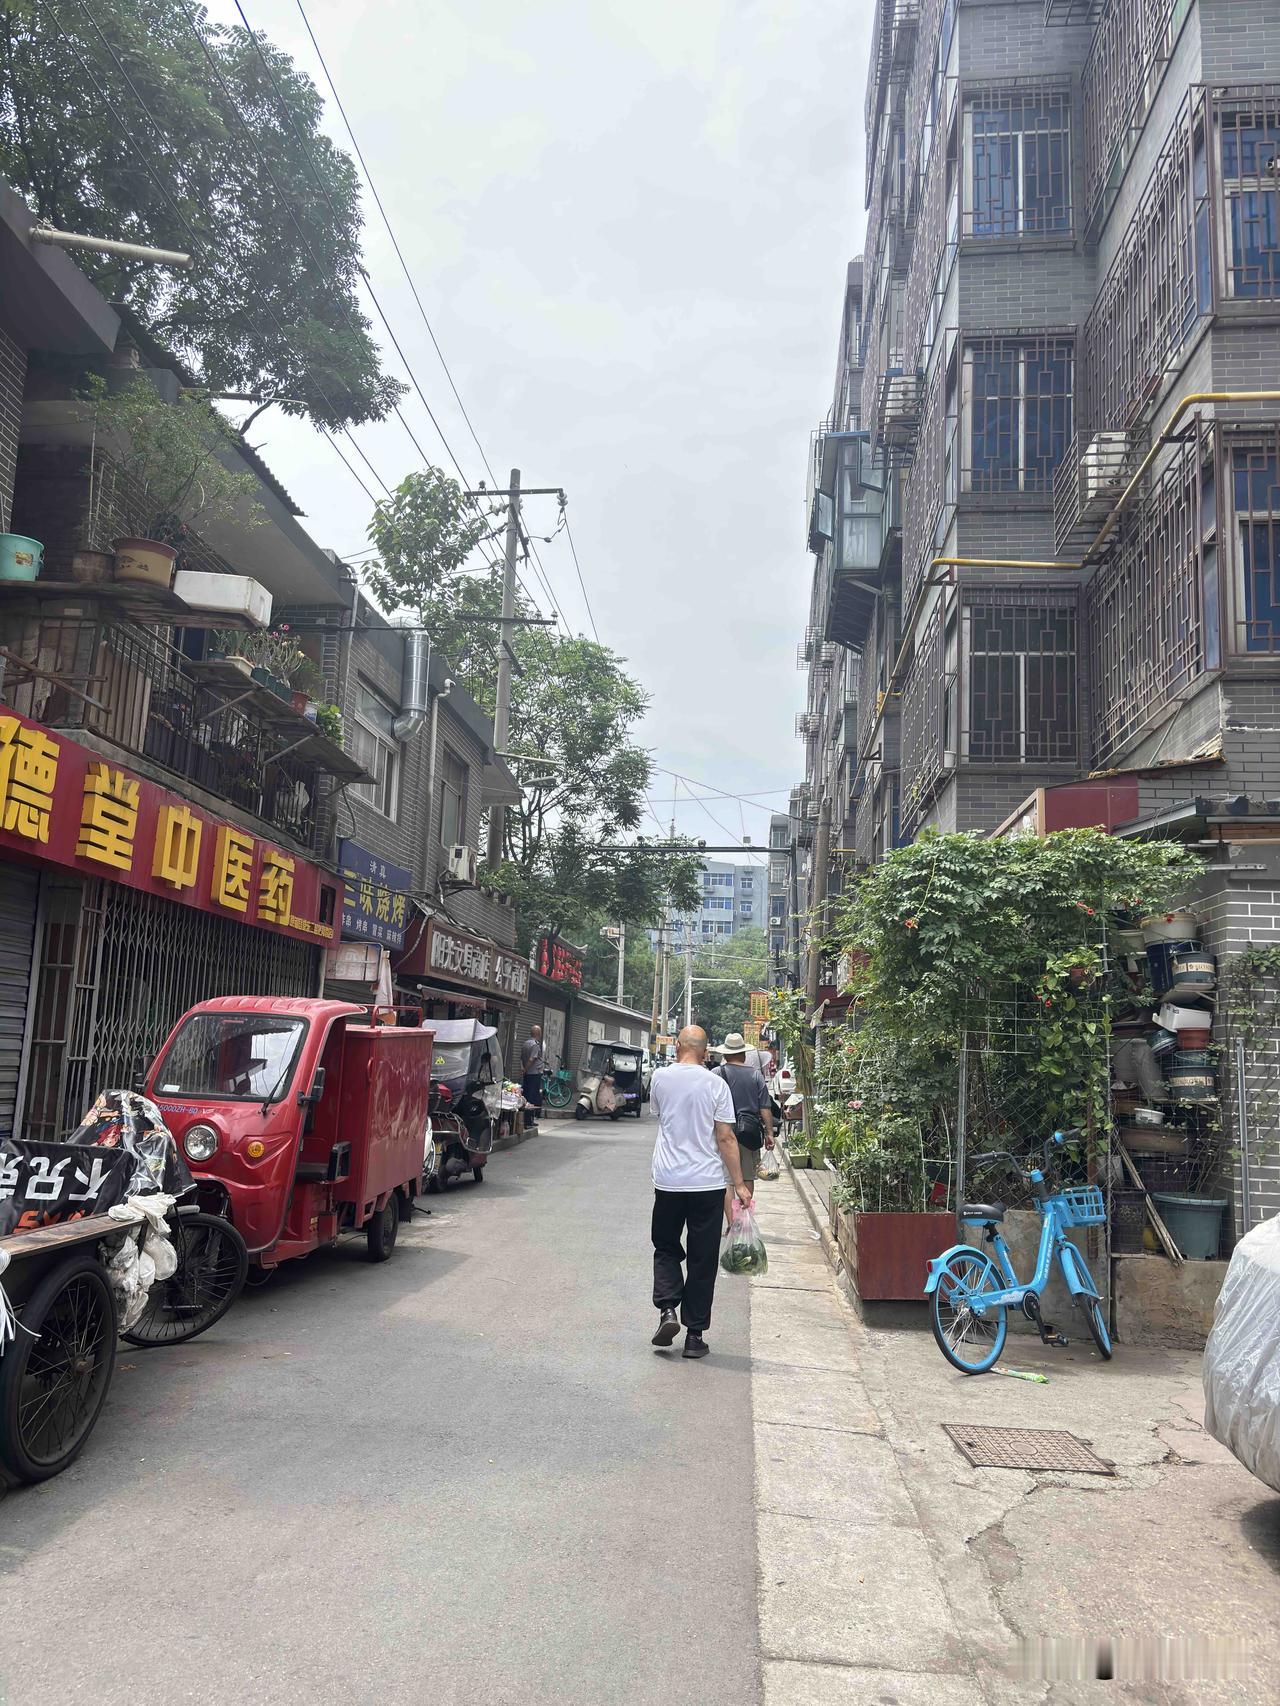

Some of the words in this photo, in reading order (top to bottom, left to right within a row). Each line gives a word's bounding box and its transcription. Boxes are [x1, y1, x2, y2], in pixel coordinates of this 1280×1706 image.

[0, 715, 295, 926] 德堂中医药
[431, 931, 491, 984] 阳光文具商店
